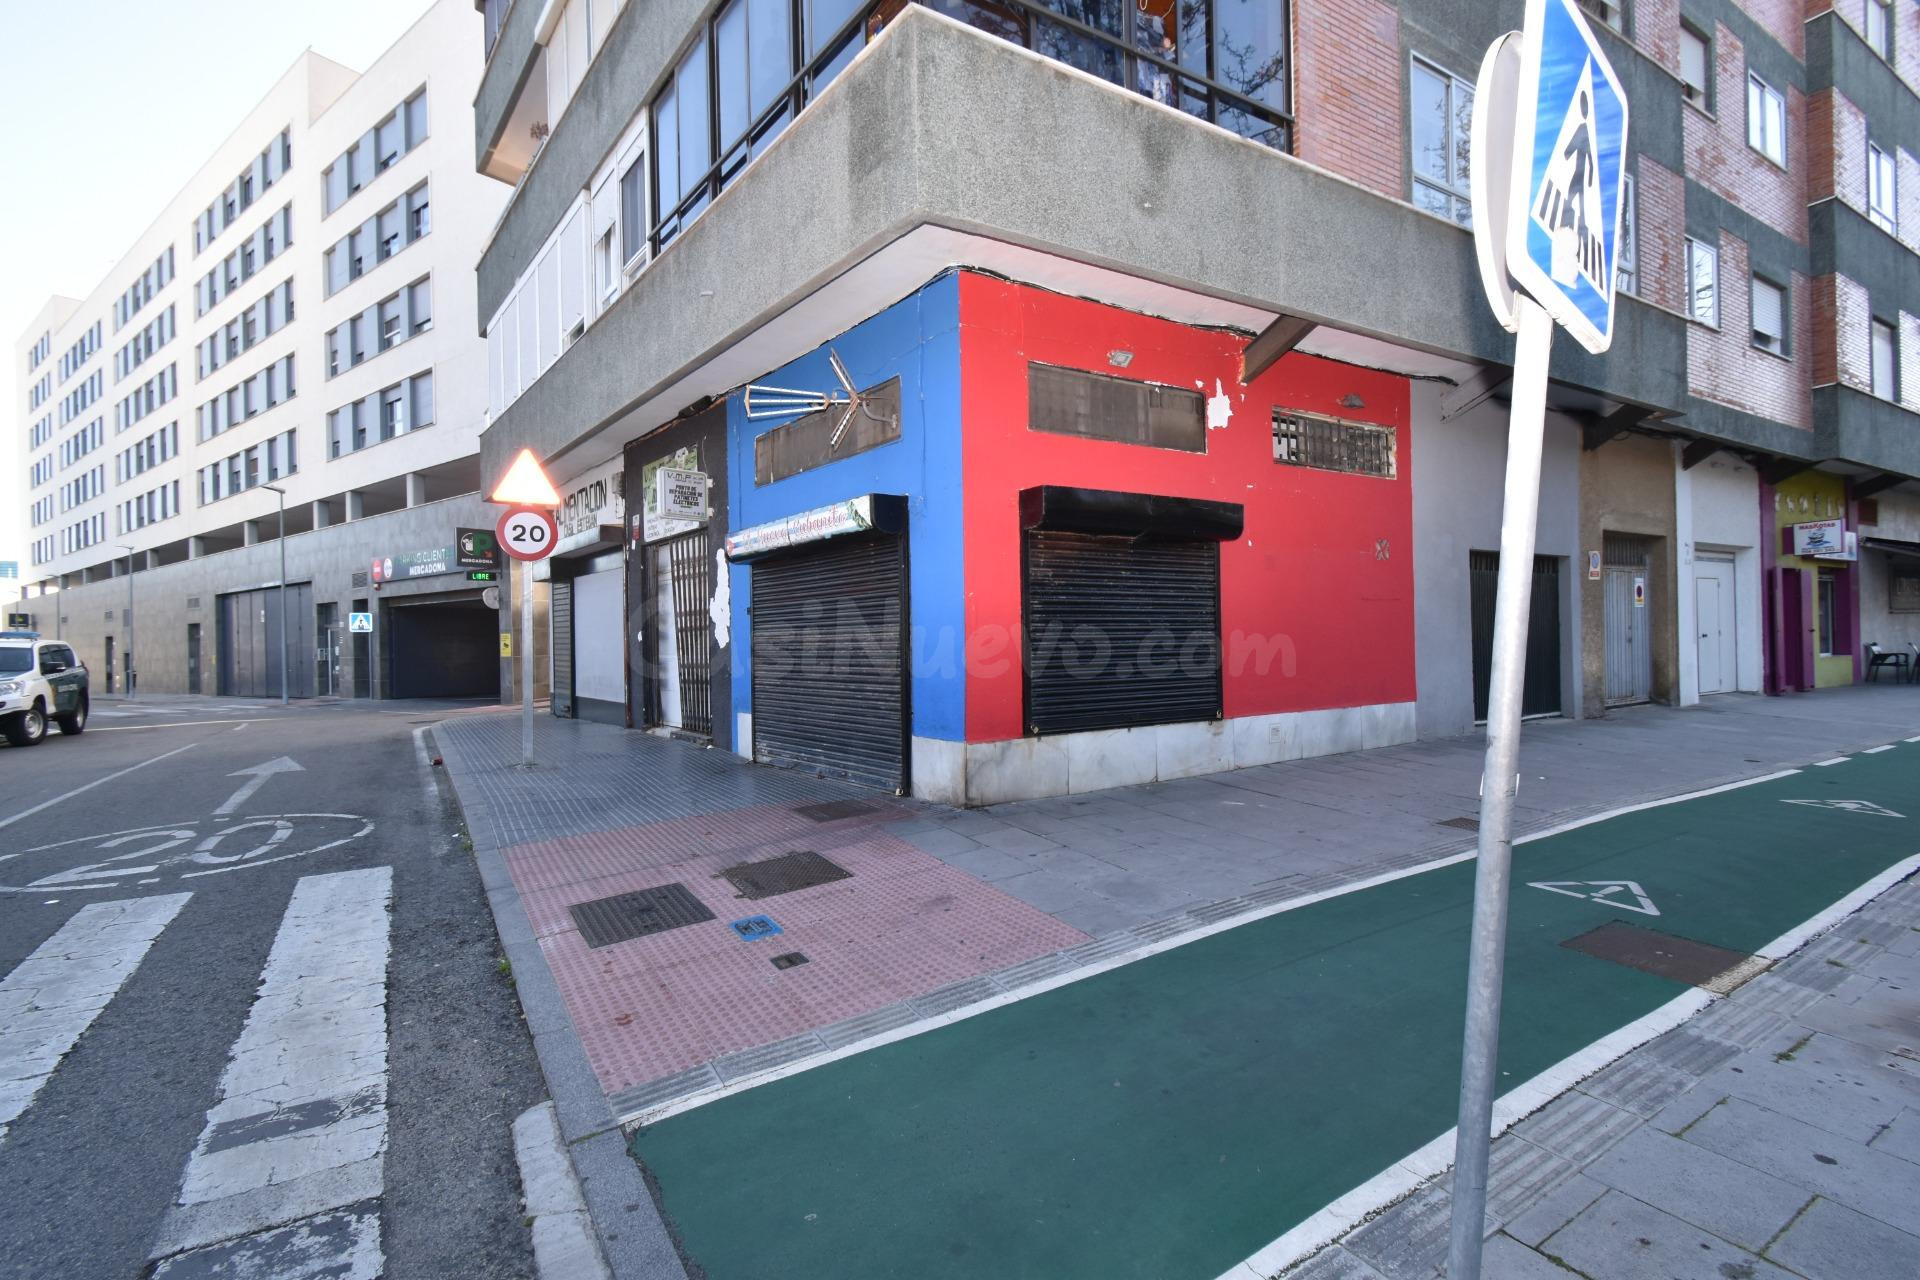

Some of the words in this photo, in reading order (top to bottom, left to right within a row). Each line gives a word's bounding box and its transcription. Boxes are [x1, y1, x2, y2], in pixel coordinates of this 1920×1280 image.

[512, 524, 545, 542] 20
[473, 532, 491, 556] P
[423, 545, 450, 562] CLIENT
[409, 562, 446, 576] MERCADONA
[27, 820, 294, 886] 20
